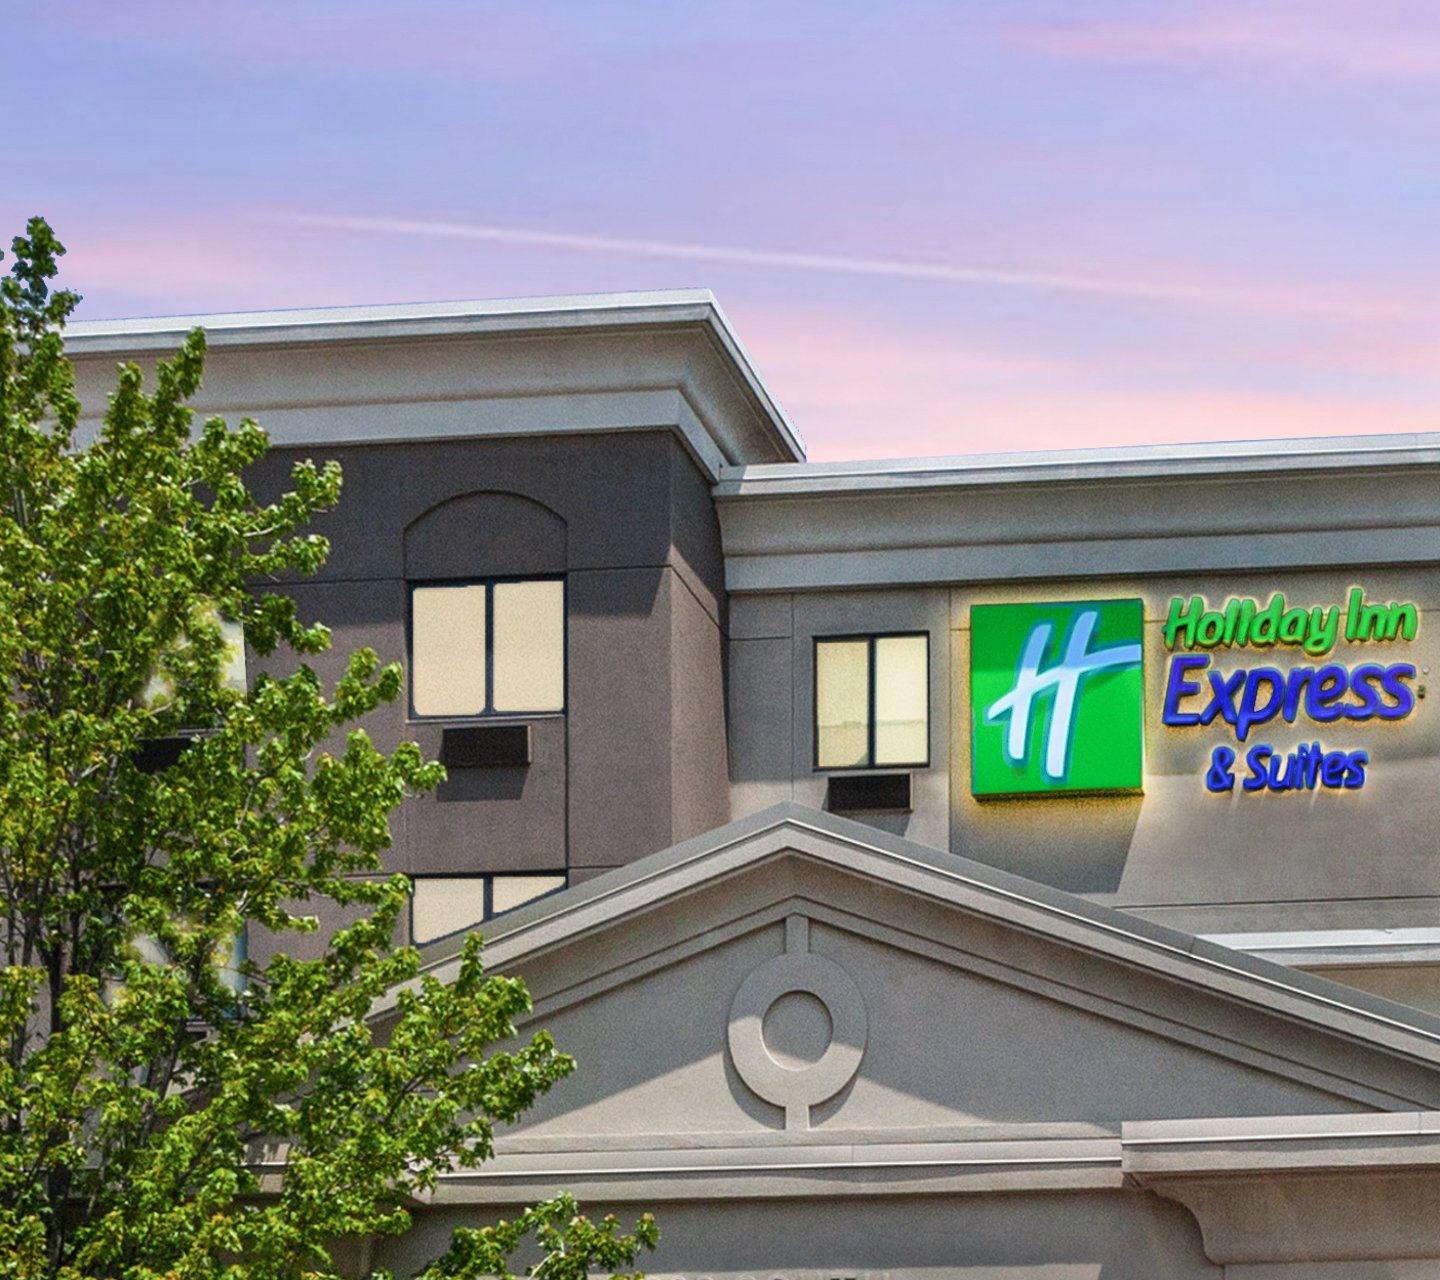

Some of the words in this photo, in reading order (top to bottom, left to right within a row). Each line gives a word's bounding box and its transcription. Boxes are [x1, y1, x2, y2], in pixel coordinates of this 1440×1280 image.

[1161, 593, 1340, 656] Holiday
[1345, 587, 1418, 642] Inn
[1162, 653, 1417, 741] Express
[1205, 745, 1235, 792] &
[1242, 741, 1369, 791] Suites
